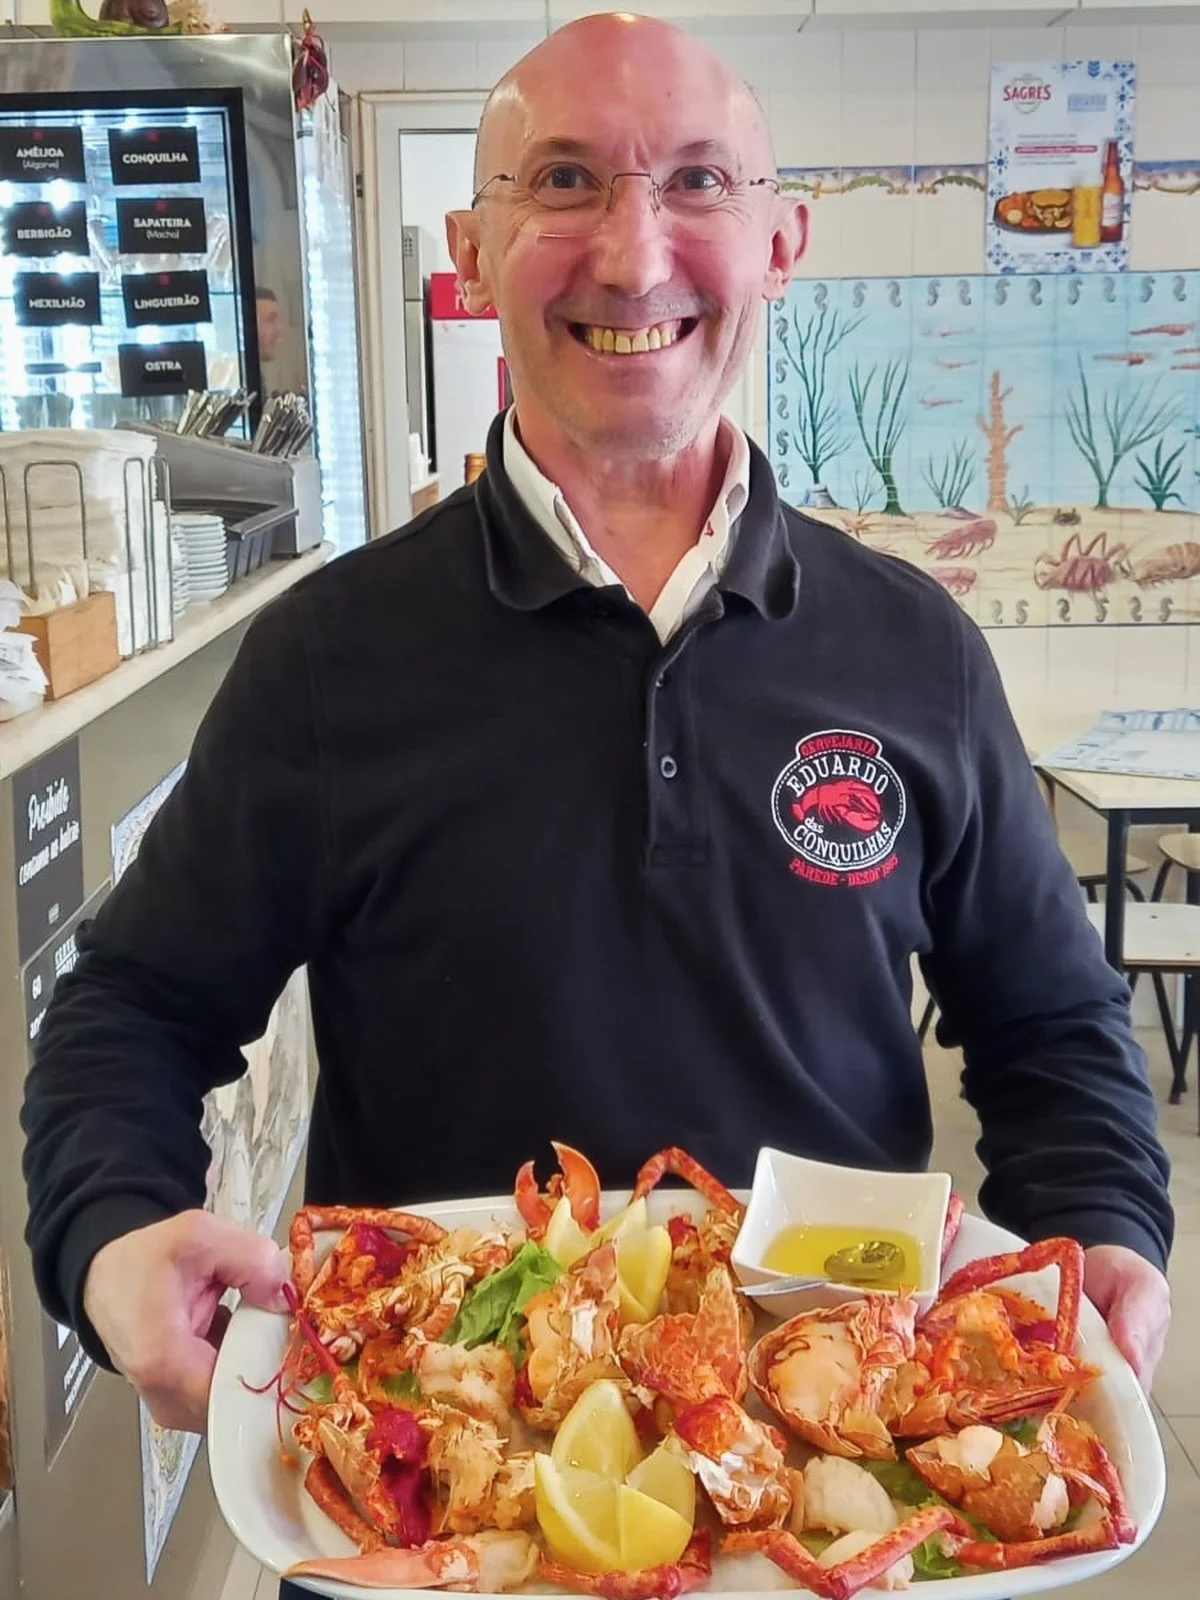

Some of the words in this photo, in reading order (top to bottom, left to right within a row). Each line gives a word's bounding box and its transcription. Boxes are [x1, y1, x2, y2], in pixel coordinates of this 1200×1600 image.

[1003, 85, 1052, 101] SAGRES
[122, 152, 189, 165] CONQUILHA
[133, 218, 192, 228] SAPATEIRA
[16, 226, 72, 239] BERBIGÃO
[29, 297, 86, 309] MEXILHÃO
[134, 295, 200, 309] LINGUEIRÃO
[145, 361, 182, 371] OSTRA
[786, 755, 889, 798] EDUARDO
[804, 816, 824, 834] das
[794, 820, 892, 865] CONQUILHAS
